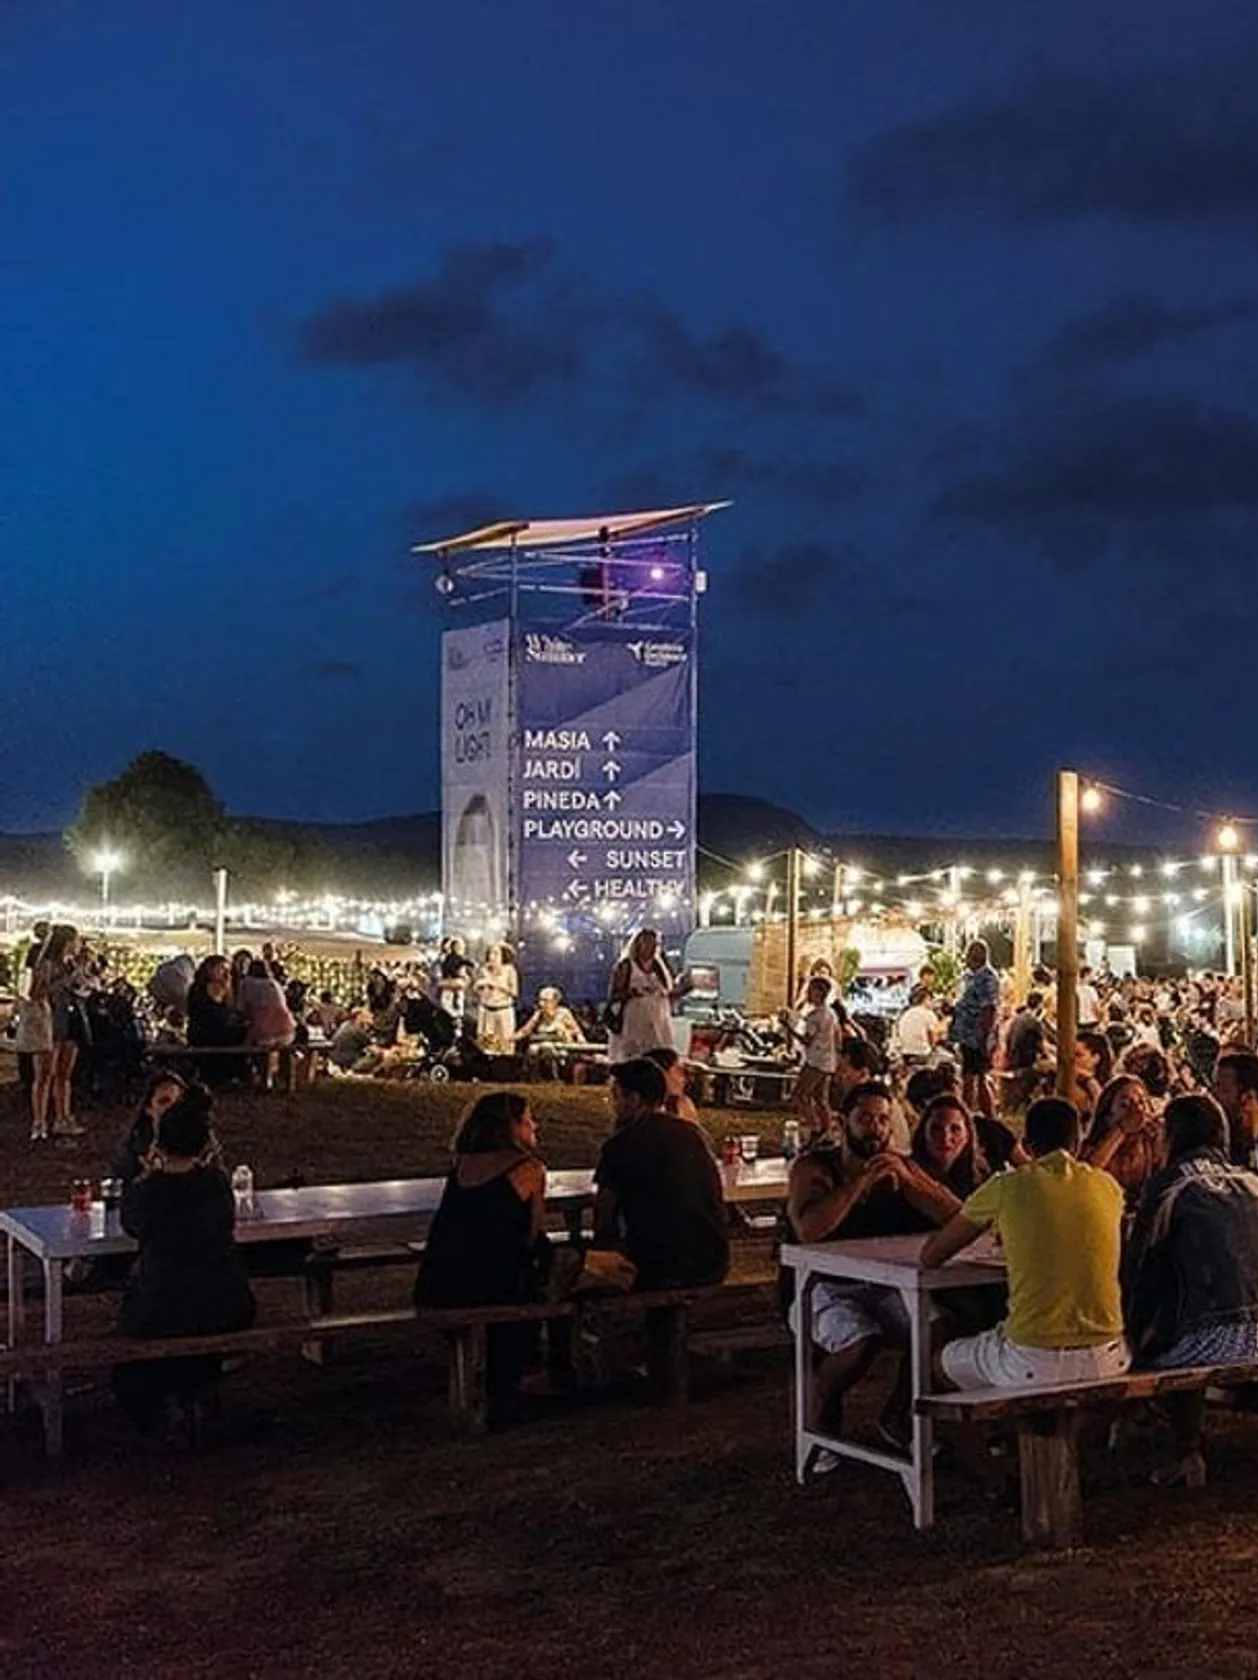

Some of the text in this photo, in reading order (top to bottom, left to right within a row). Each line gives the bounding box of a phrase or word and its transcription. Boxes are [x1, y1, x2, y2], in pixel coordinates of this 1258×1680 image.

[523, 730, 591, 750] MASIA
[522, 757, 582, 780] JARDÍ
[522, 790, 600, 810] PINEDA
[523, 819, 664, 840] PLAYGROUND
[606, 850, 687, 869] SUNSET
[594, 877, 685, 899] HEALTHY
